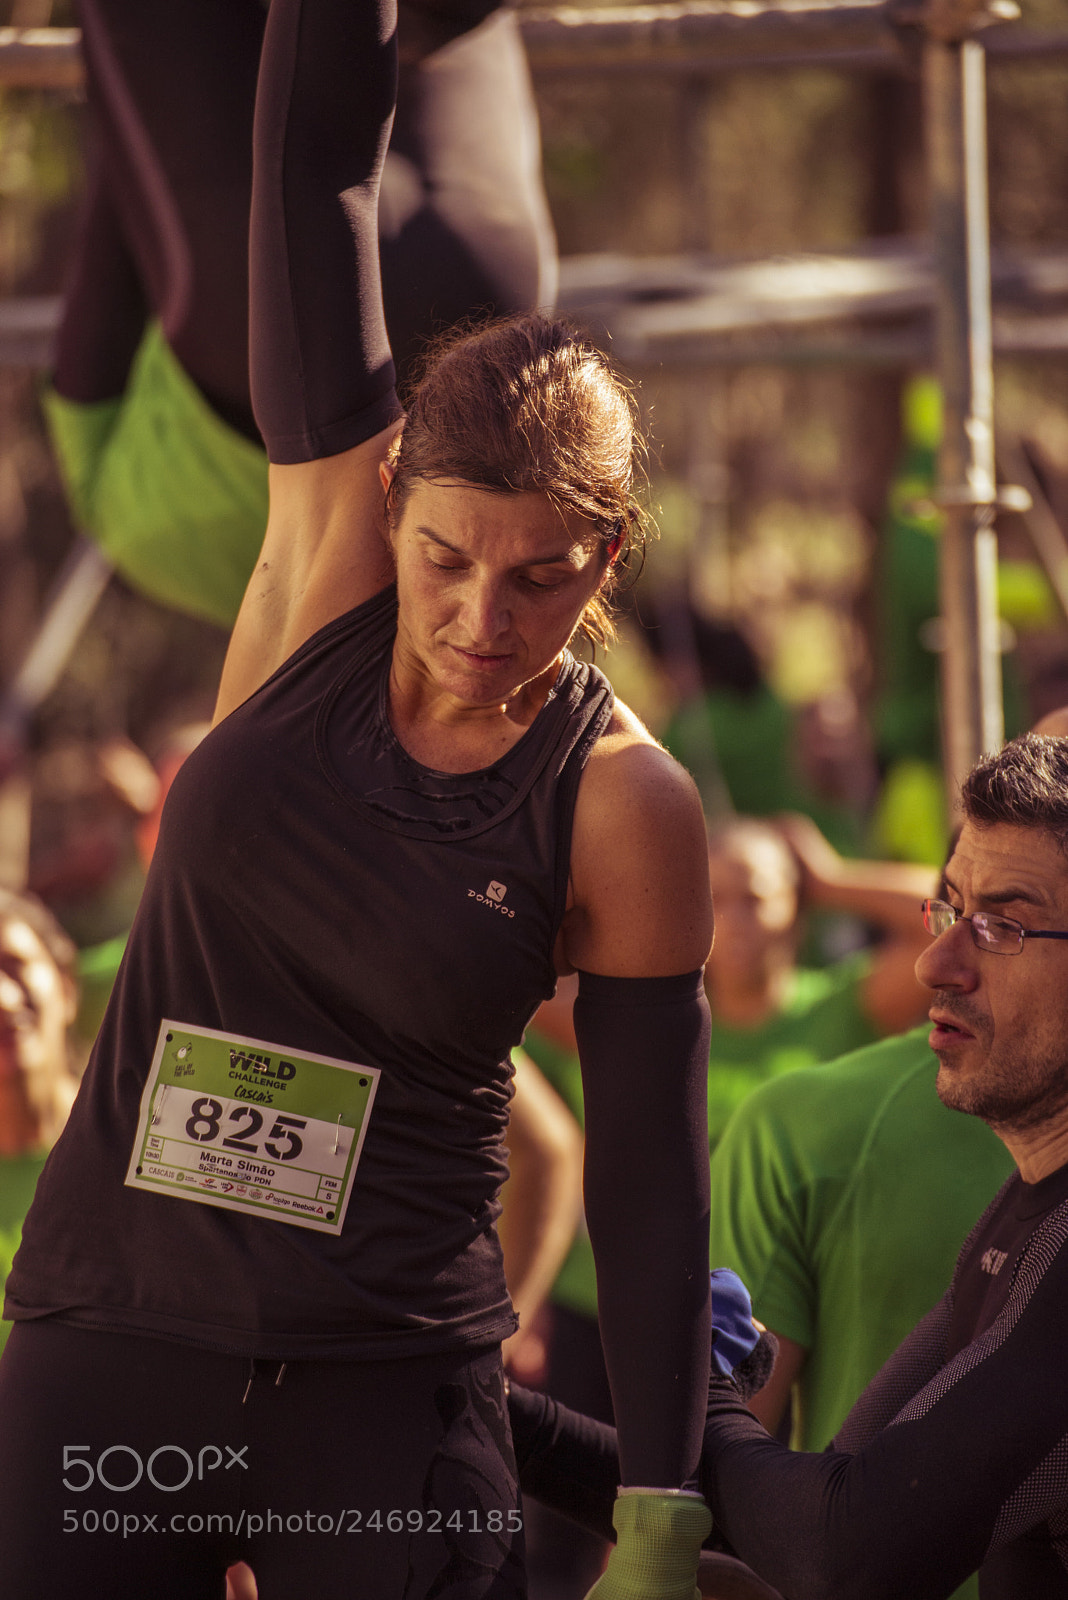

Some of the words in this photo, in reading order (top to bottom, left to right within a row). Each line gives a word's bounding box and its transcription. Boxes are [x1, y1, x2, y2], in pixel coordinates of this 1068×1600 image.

[467, 889, 516, 918] DOMYOS
[229, 1048, 297, 1081] WILD
[228, 1071, 287, 1091] CHALLENGE
[234, 1084, 274, 1104] Cascais
[185, 1097, 308, 1161] 825
[148, 1166, 176, 1179] CASCAIS
[200, 1151, 233, 1167] Marta
[237, 1159, 276, 1177] Simão
[254, 1176, 272, 1186] PDN
[325, 1180, 337, 1188] FEM
[325, 1192, 332, 1201] S
[291, 1201, 317, 1213] Reebok
